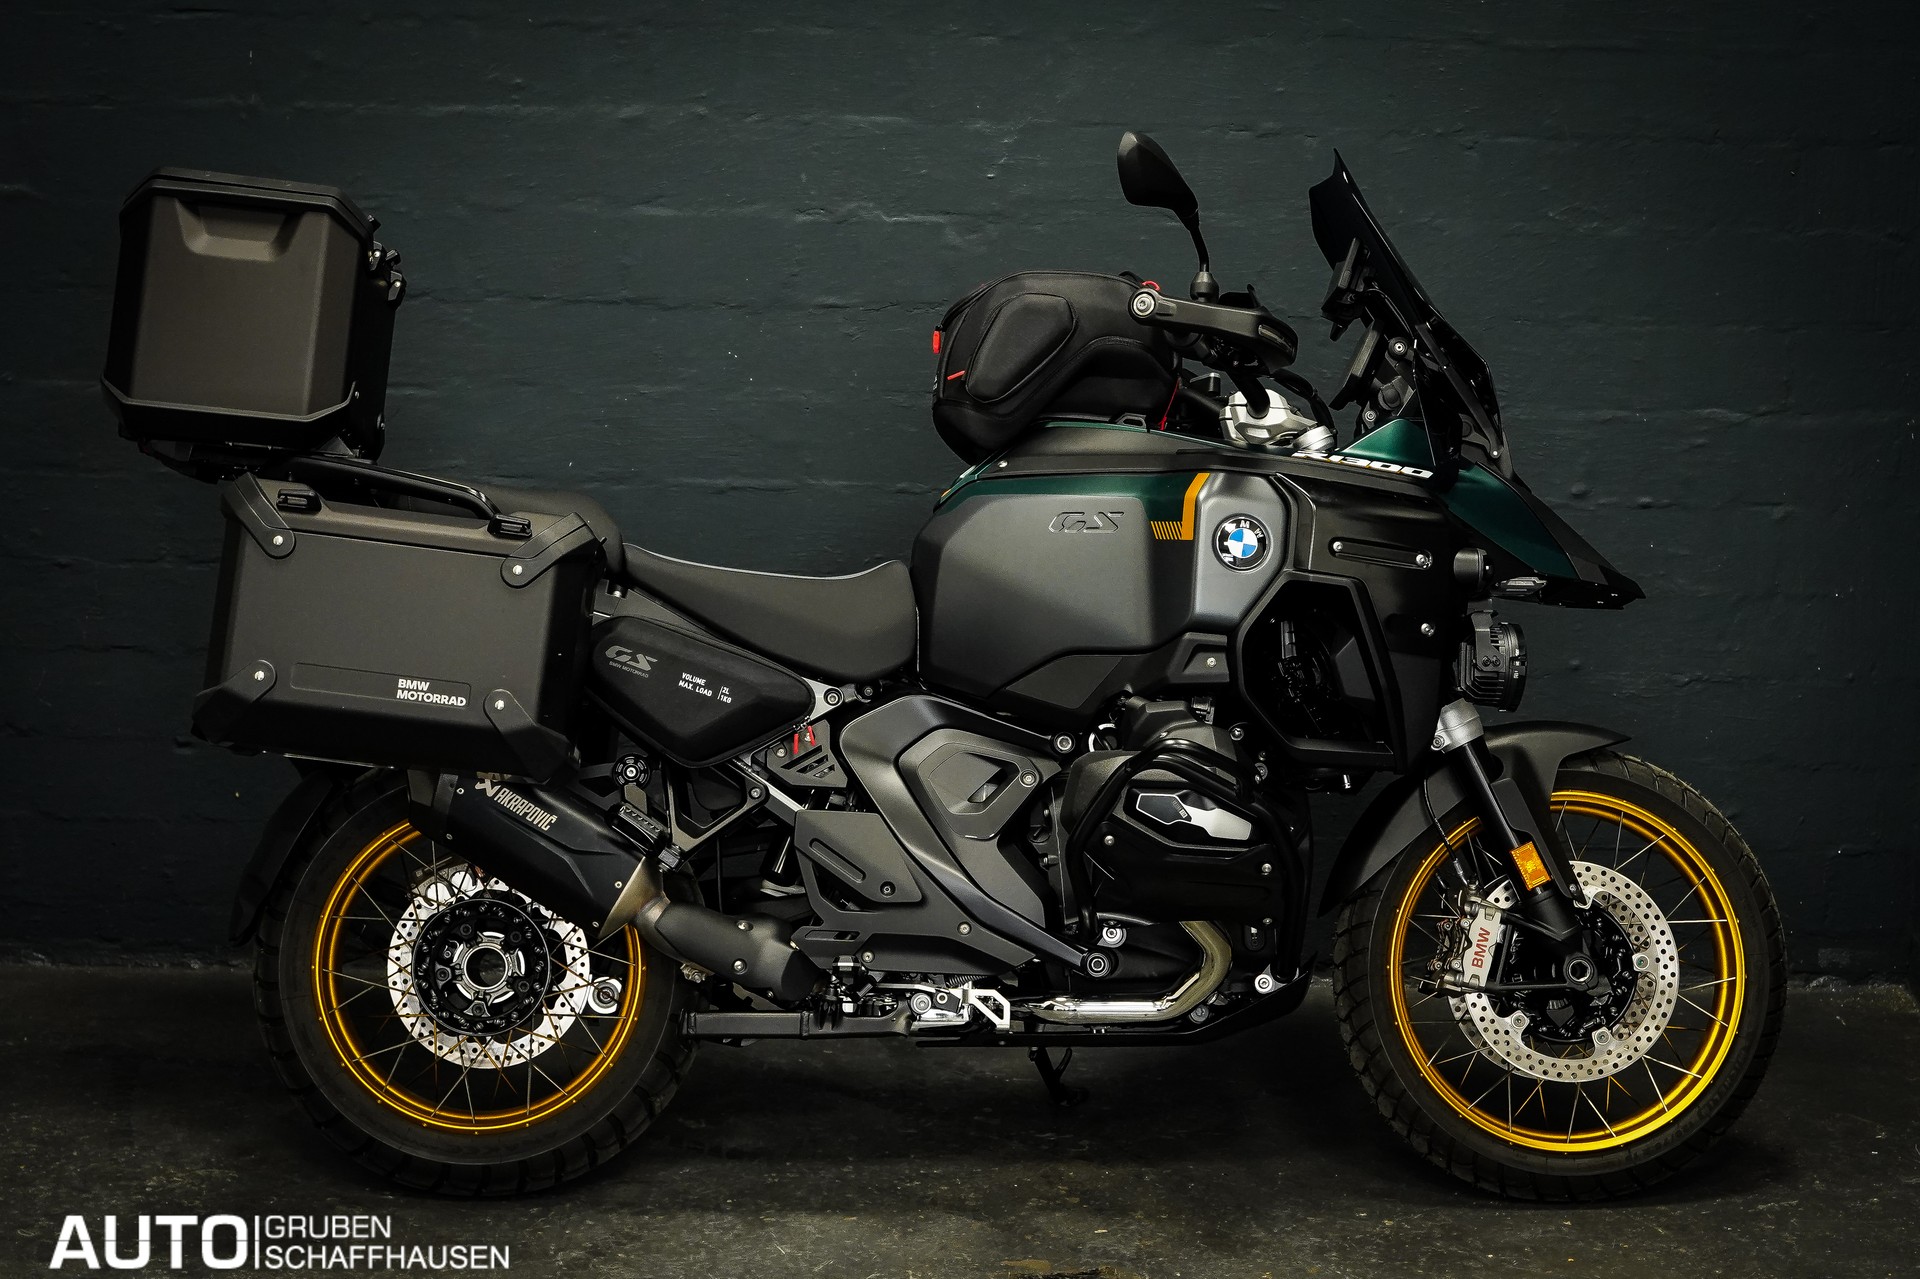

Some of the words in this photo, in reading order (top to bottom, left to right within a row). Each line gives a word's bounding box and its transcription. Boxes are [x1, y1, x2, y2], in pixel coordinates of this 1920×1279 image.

[1049, 511, 1125, 533] GS
[605, 645, 658, 671] GS
[397, 678, 430, 691] BMW
[678, 679, 694, 691] MAX.
[695, 685, 713, 697] LOAD
[681, 672, 707, 686] VOLUME
[396, 689, 467, 707] MOTORRAD
[1471, 927, 1491, 969] BMW
